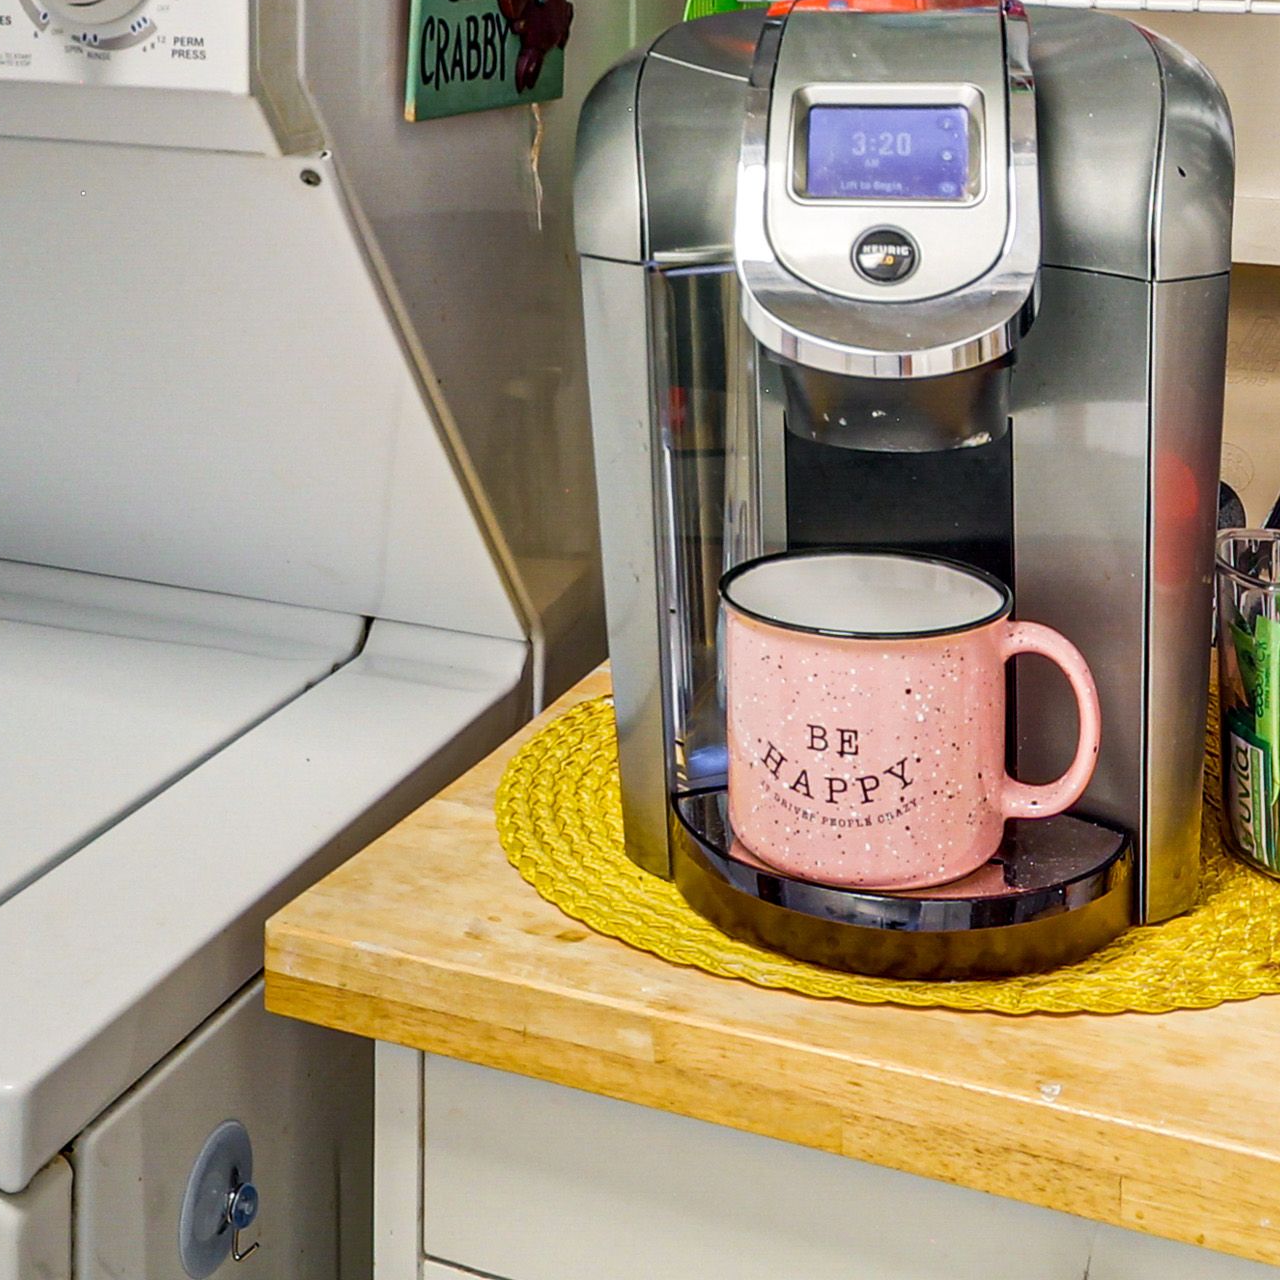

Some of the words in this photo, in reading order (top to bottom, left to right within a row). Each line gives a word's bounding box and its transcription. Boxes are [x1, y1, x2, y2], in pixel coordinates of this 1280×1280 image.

[173, 36, 204, 47] PERM
[421, 12, 512, 91] CRABBY
[171, 49, 206, 60] PRESS
[852, 132, 912, 156] 3:20
[862, 245, 910, 256] KEURIG
[806, 724, 859, 758] BE
[760, 740, 914, 804] HAPPY
